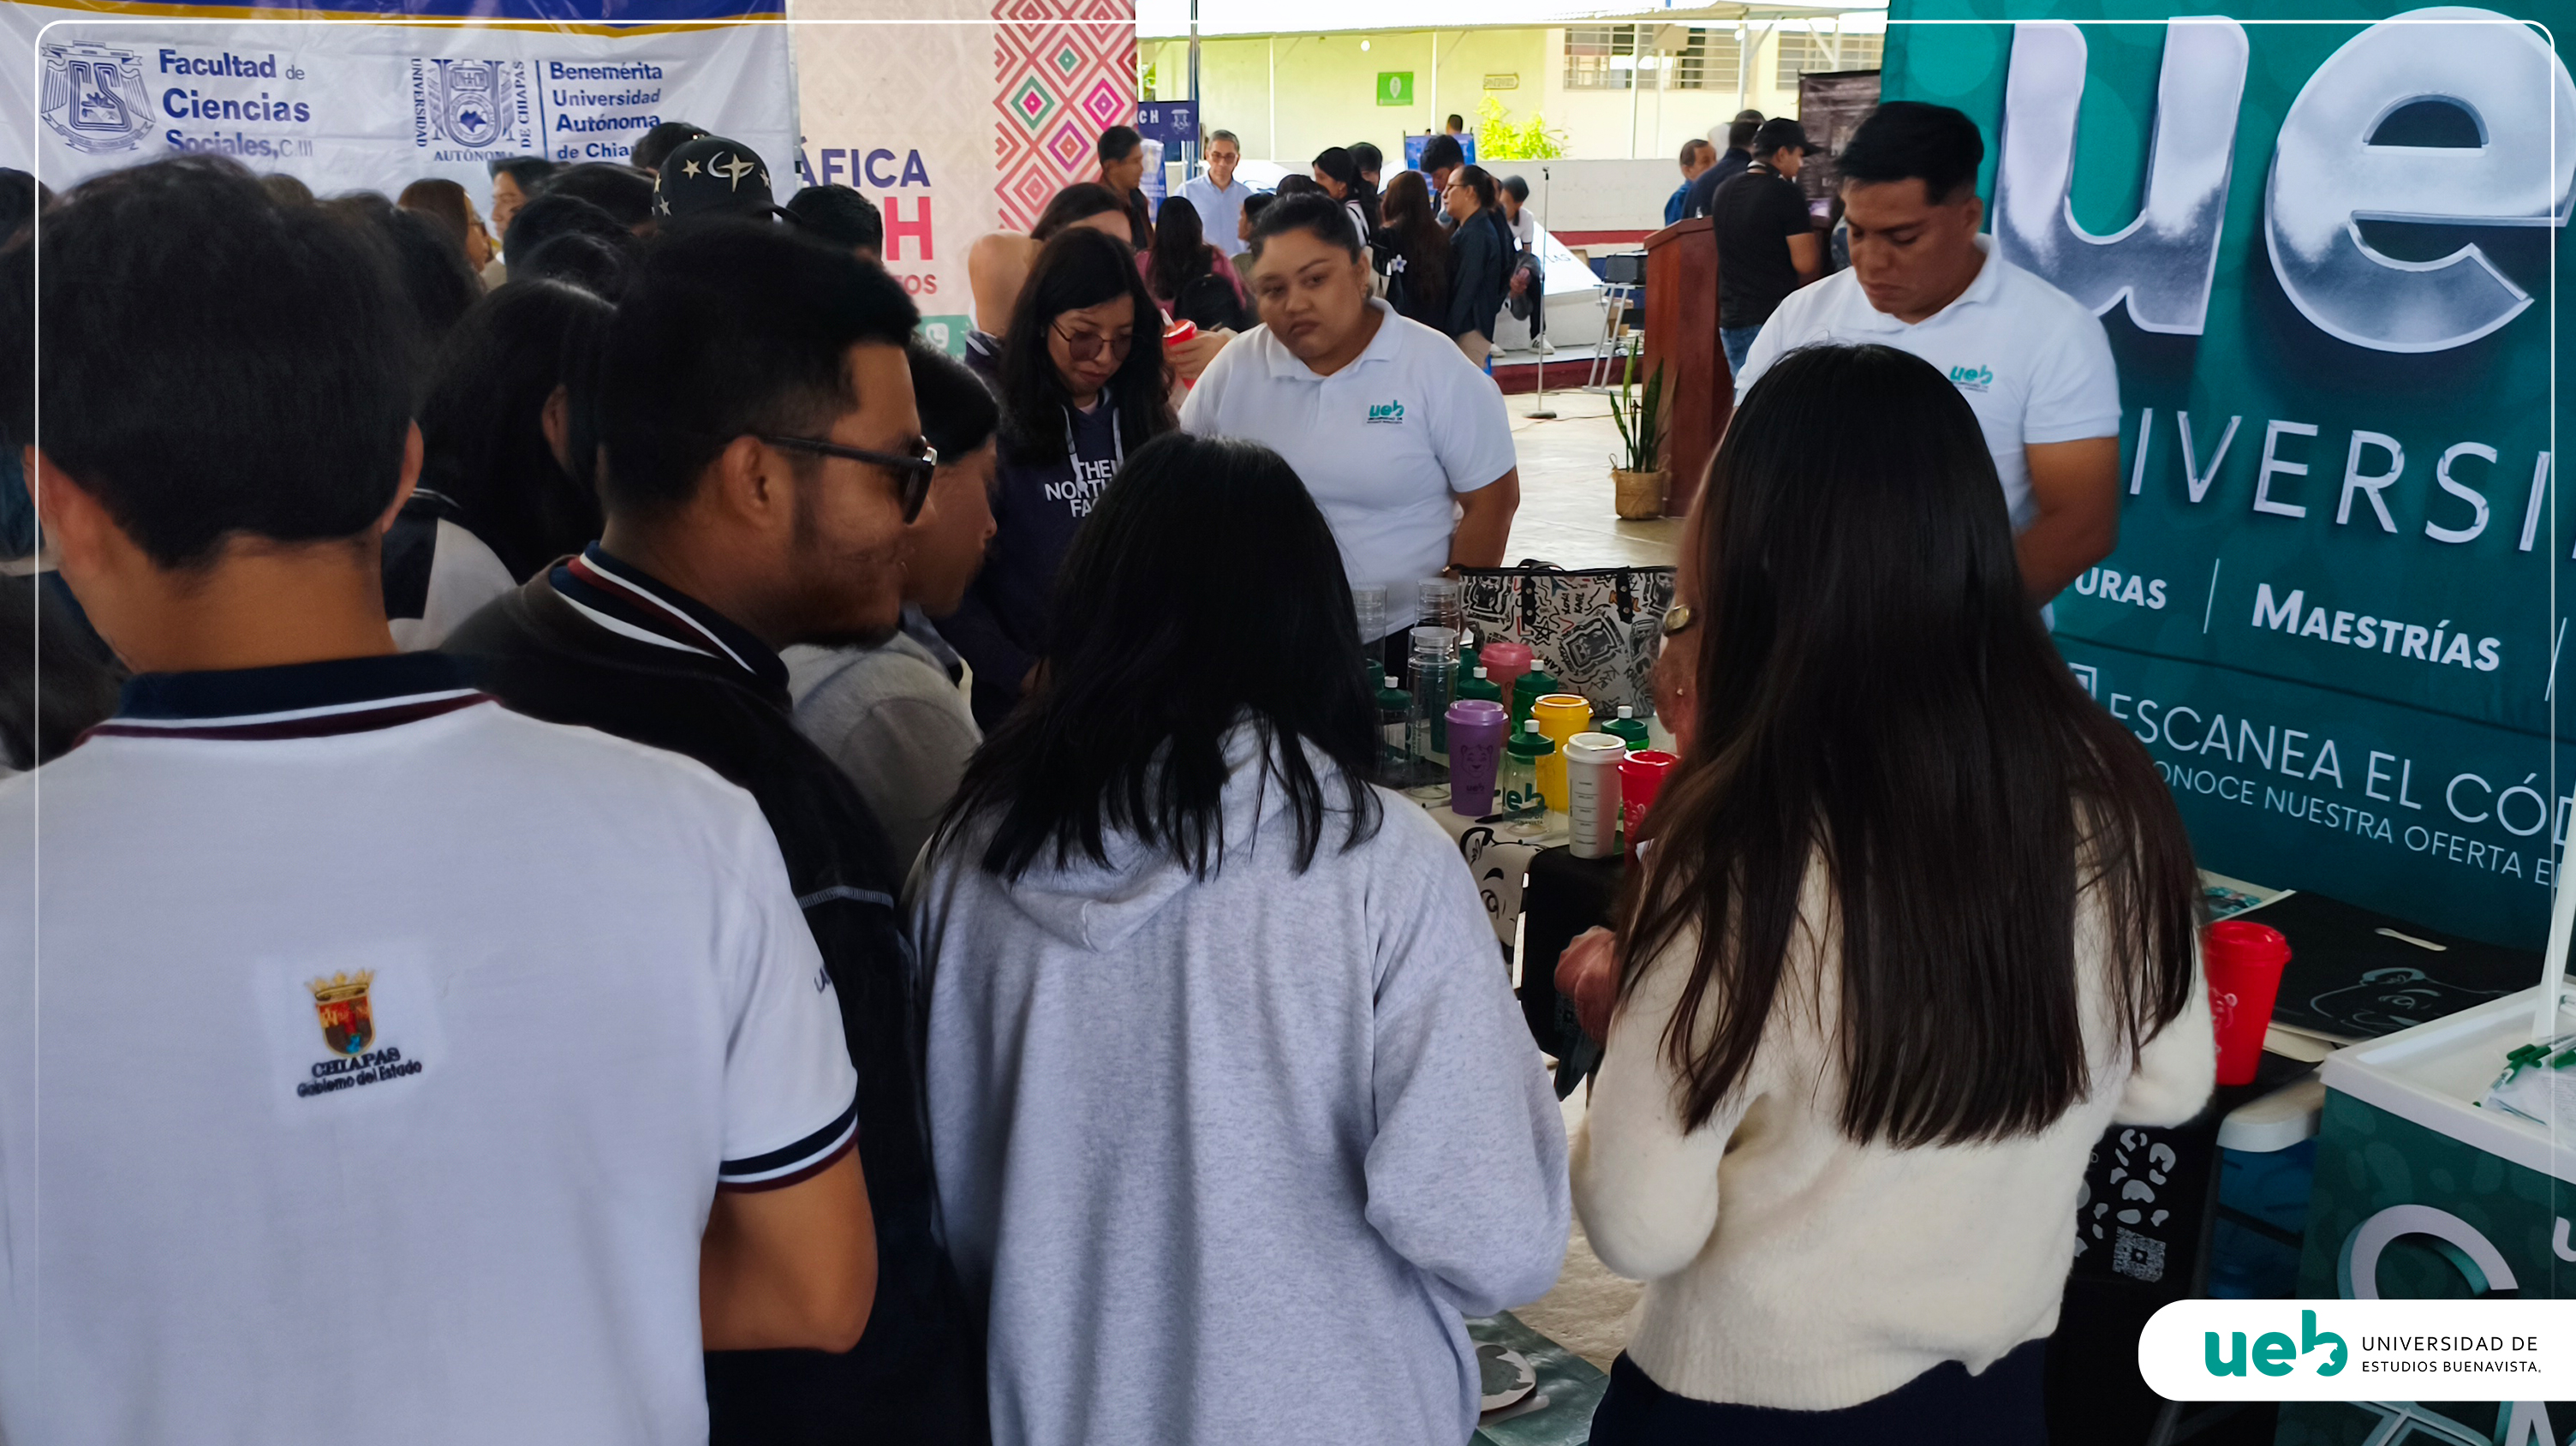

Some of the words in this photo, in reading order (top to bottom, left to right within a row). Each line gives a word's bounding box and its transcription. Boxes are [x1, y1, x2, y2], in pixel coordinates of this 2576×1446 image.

[158, 49, 277, 79] Facultad
[285, 64, 306, 81] de
[550, 61, 663, 80] Benemérita
[162, 87, 311, 122] Ciencias
[411, 58, 428, 147] UNIVERSIDAD
[513, 61, 530, 124] CHIAPAS
[552, 88, 661, 106] Universidad
[518, 128, 532, 148] DE
[556, 114, 661, 132] Autónoma
[165, 128, 280, 159] Sociales,
[557, 144, 580, 159] de
[585, 142, 635, 158] Chia
[1950, 364, 1994, 385] ueb
[1368, 399, 1404, 417] ueb
[2129, 407, 2576, 559] IVERSI
[2365, 750, 2423, 810] EL
[2264, 786, 2394, 844] NUESTRA
[2403, 825, 2522, 879] OFERTA
[311, 1046, 402, 1078] CHIAPAS
[296, 1073, 355, 1098] Gobierno
[356, 1066, 379, 1086] del
[379, 1059, 423, 1082] Estado
